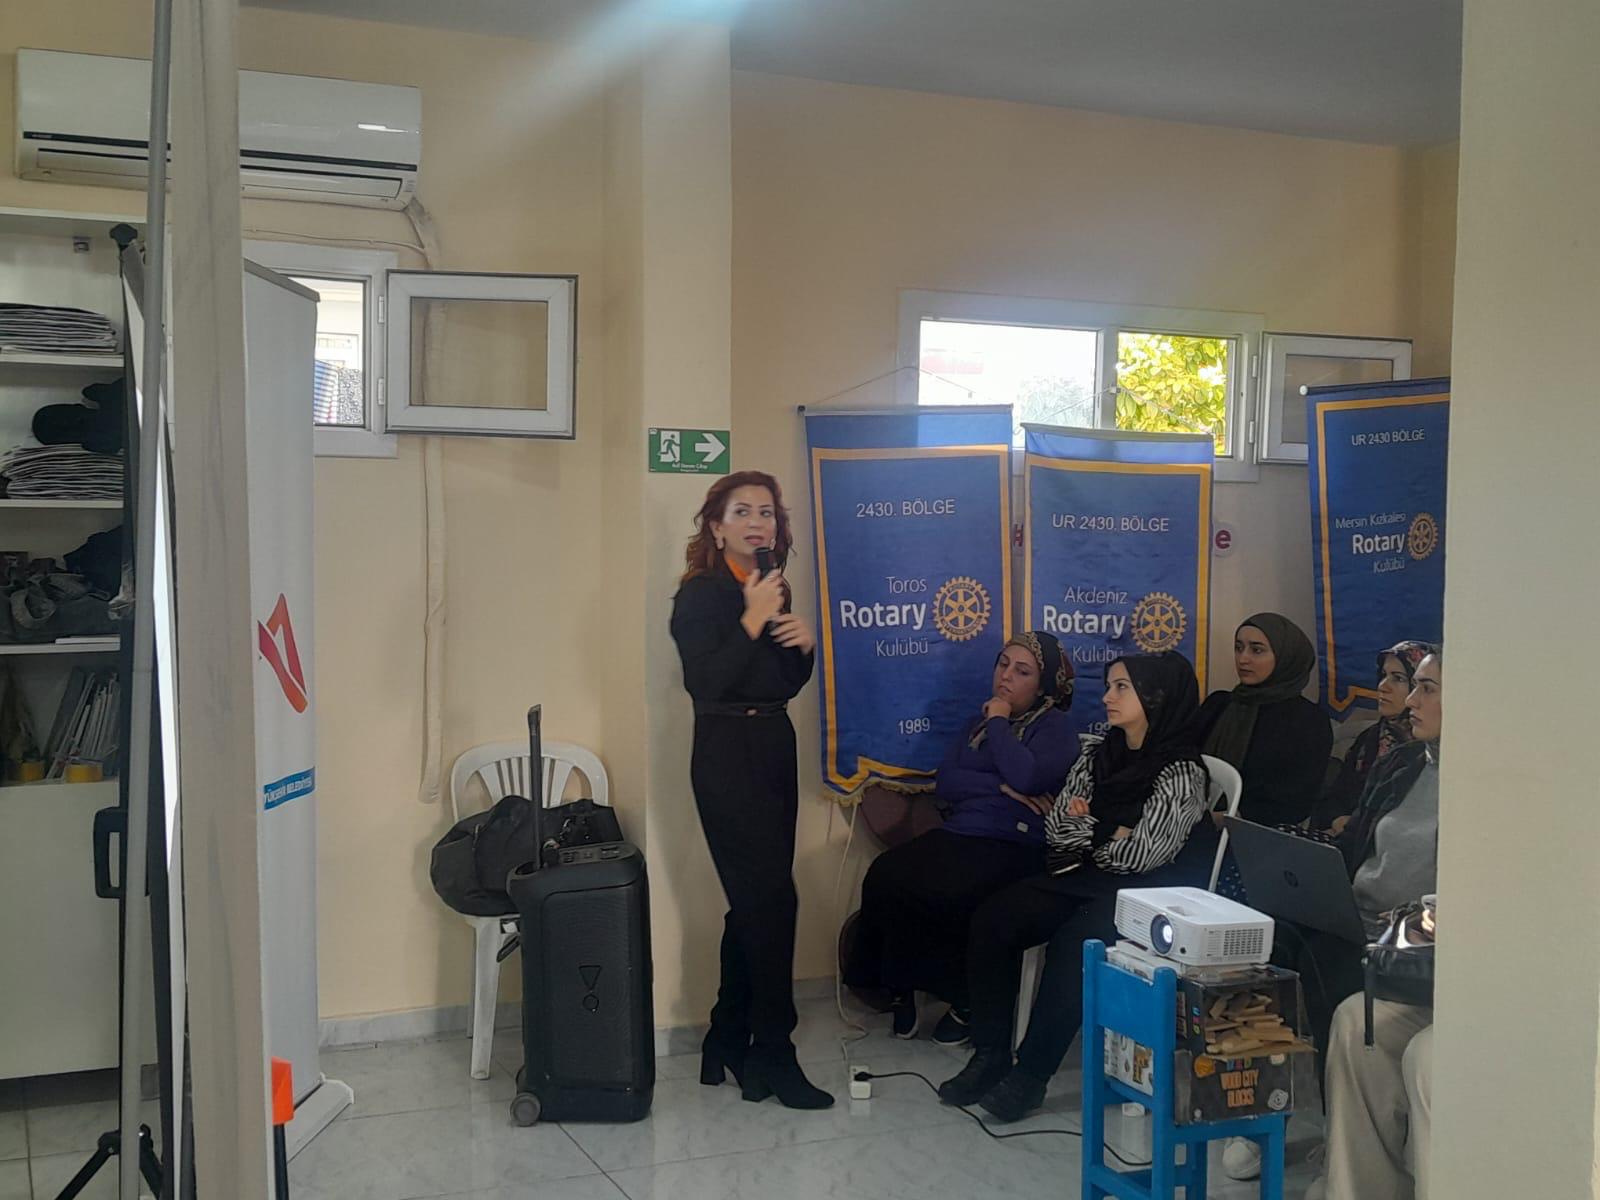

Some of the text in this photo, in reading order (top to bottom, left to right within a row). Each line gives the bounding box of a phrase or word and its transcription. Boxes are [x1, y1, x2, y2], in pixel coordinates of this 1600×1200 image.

[1351, 433, 1367, 446] UR
[1368, 431, 1391, 445] 2430
[856, 498, 956, 518] 2430. BÖLGE
[1052, 514, 1170, 532] UR 2430. BÖLGE
[1352, 533, 1405, 554] Rotary
[886, 576, 928, 594] Toros
[839, 600, 927, 630] Rotary
[1043, 604, 1126, 640] Rotary
[876, 637, 928, 657] Kulübü
[898, 717, 931, 735] 1989
